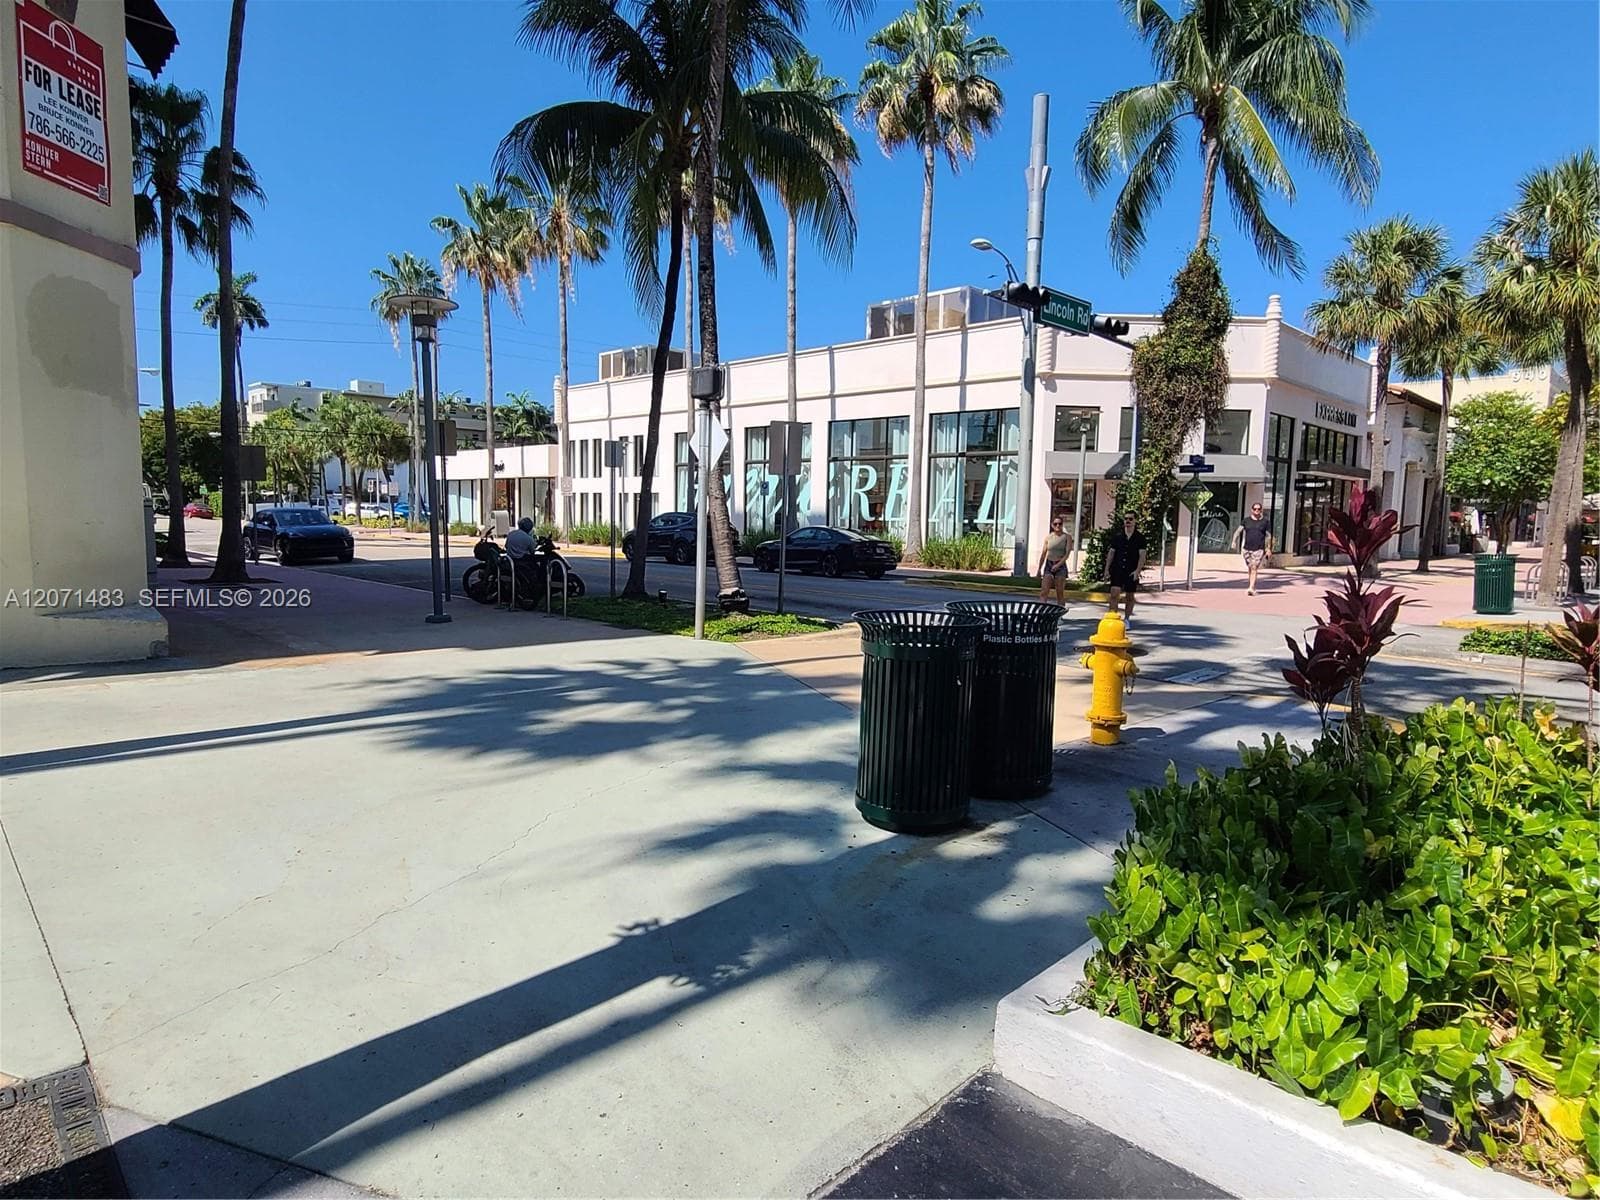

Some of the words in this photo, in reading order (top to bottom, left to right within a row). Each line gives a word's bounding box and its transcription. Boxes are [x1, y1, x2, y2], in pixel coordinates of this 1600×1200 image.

[24, 59, 52, 94] FOR
[58, 78, 102, 121] LEASE
[38, 103, 64, 122] BRUCE
[66, 115, 95, 138] KONIVER
[43, 95, 58, 108] LEE
[59, 103, 89, 125] KONIVER
[27, 110, 105, 163] 786-566-2225
[25, 138, 60, 163] KONIVER
[25, 149, 52, 170] STERN
[1077, 307, 1089, 326] Rd
[983, 634, 1013, 643] Plastic
[1014, 635, 1042, 644] Bottles
